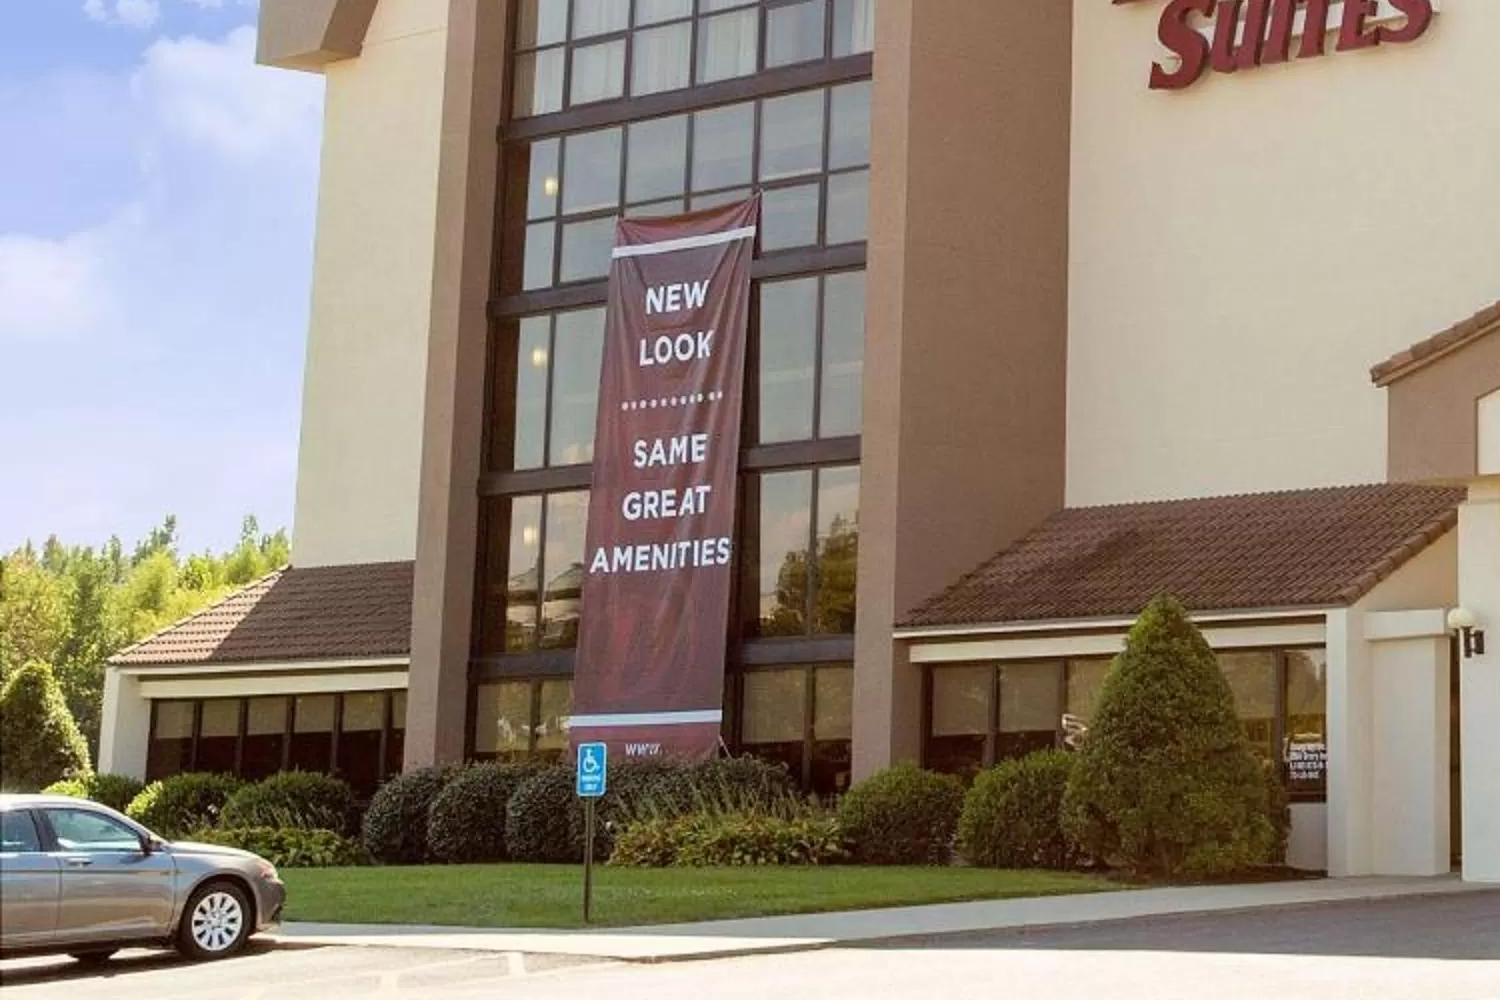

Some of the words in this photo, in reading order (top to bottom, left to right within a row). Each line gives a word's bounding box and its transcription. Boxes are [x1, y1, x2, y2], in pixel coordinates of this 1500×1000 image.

[645, 279, 711, 315] NEW
[639, 329, 715, 367] LOOK
[633, 433, 709, 468] SAME
[621, 485, 712, 520] GREAT
[589, 537, 732, 574] AMENITIES
